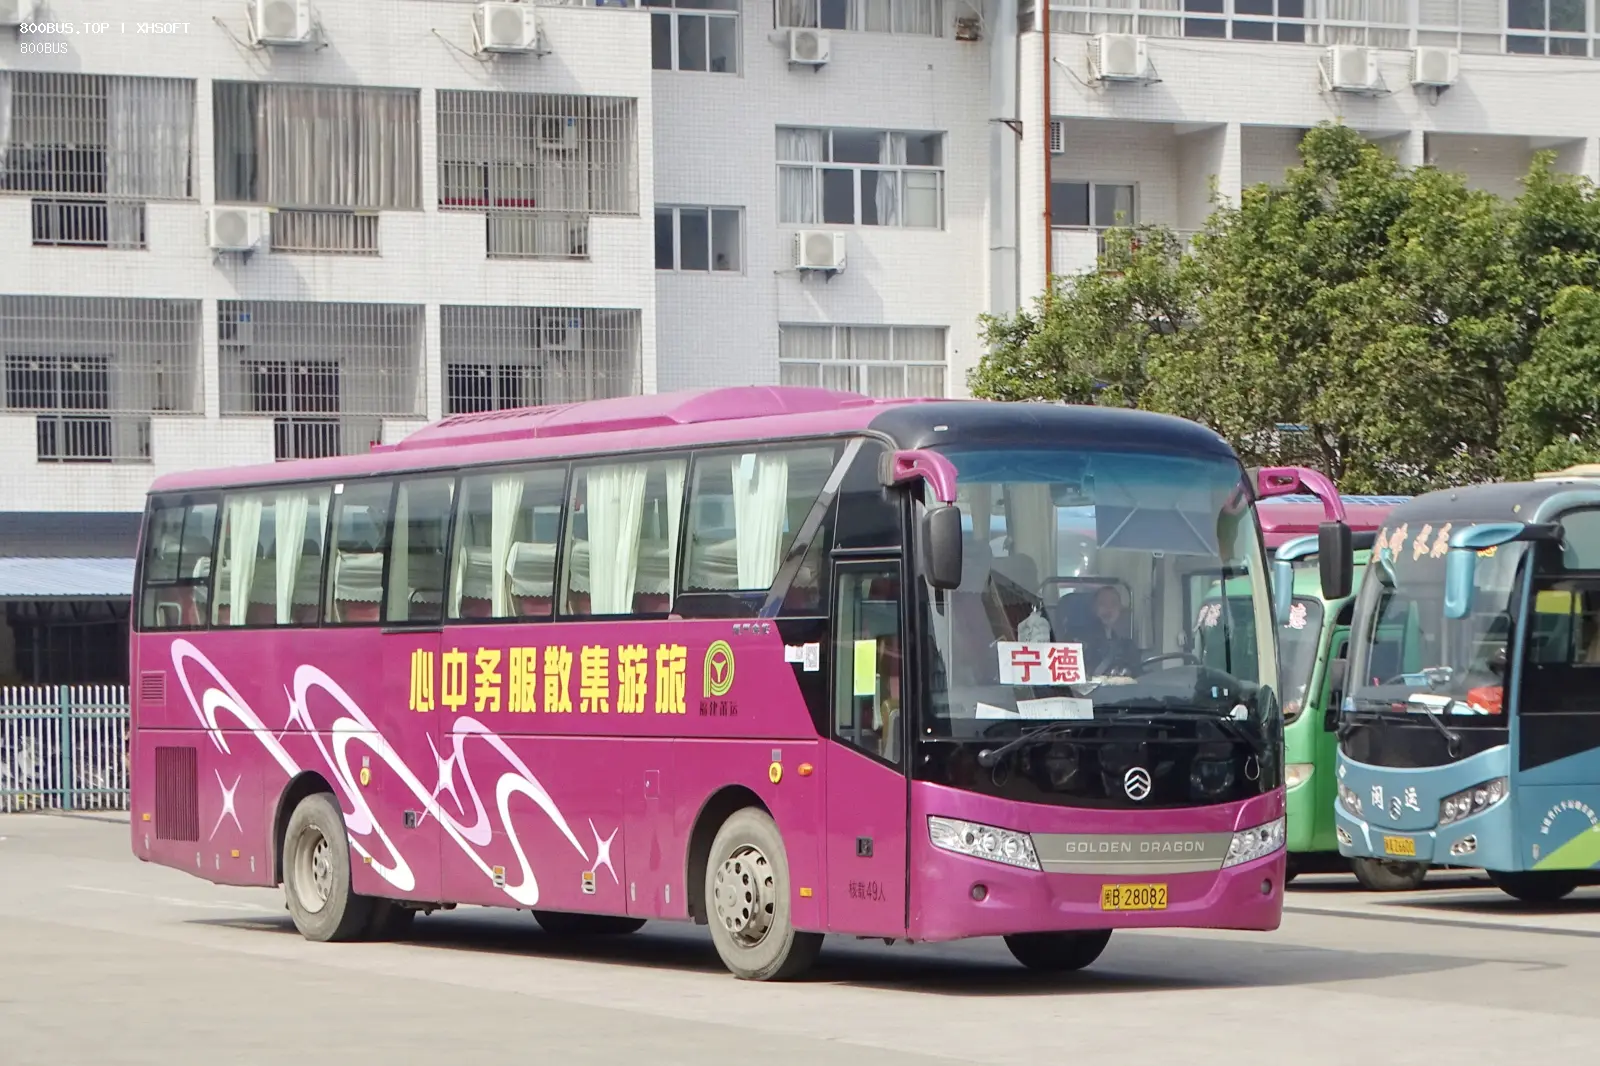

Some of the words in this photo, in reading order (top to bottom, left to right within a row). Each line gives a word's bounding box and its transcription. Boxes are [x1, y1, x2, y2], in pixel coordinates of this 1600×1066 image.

[1011, 646, 1081, 683] 宁德
[1065, 841, 1132, 854] GOLDEN
[1139, 840, 1206, 853] DRAGON
